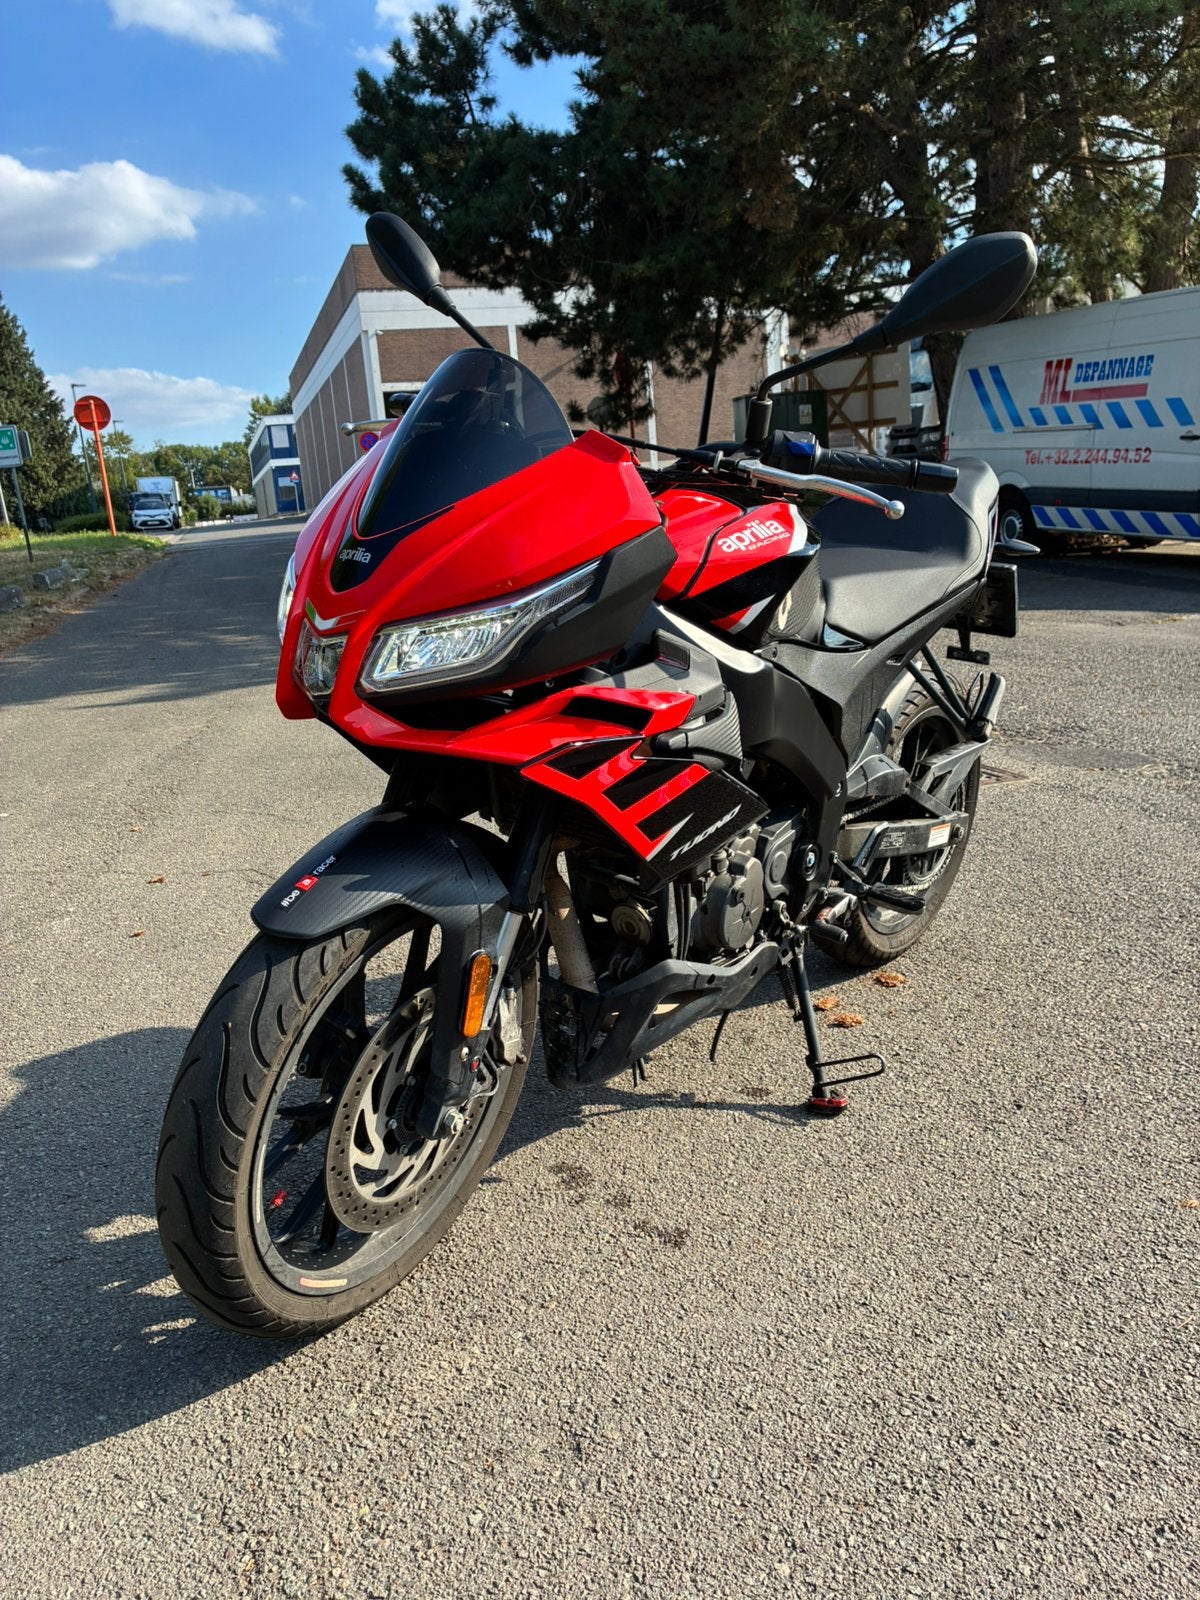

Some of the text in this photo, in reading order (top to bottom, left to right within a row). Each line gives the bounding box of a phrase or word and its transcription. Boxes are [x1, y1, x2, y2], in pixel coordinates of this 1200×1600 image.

[1039, 354, 1155, 405] ML DEPANNAGE
[340, 546, 371, 563] aprilia
[717, 519, 786, 553] aprilia
[669, 803, 742, 862] TUONO
[280, 889, 300, 907] #be
[312, 855, 336, 875] racer
